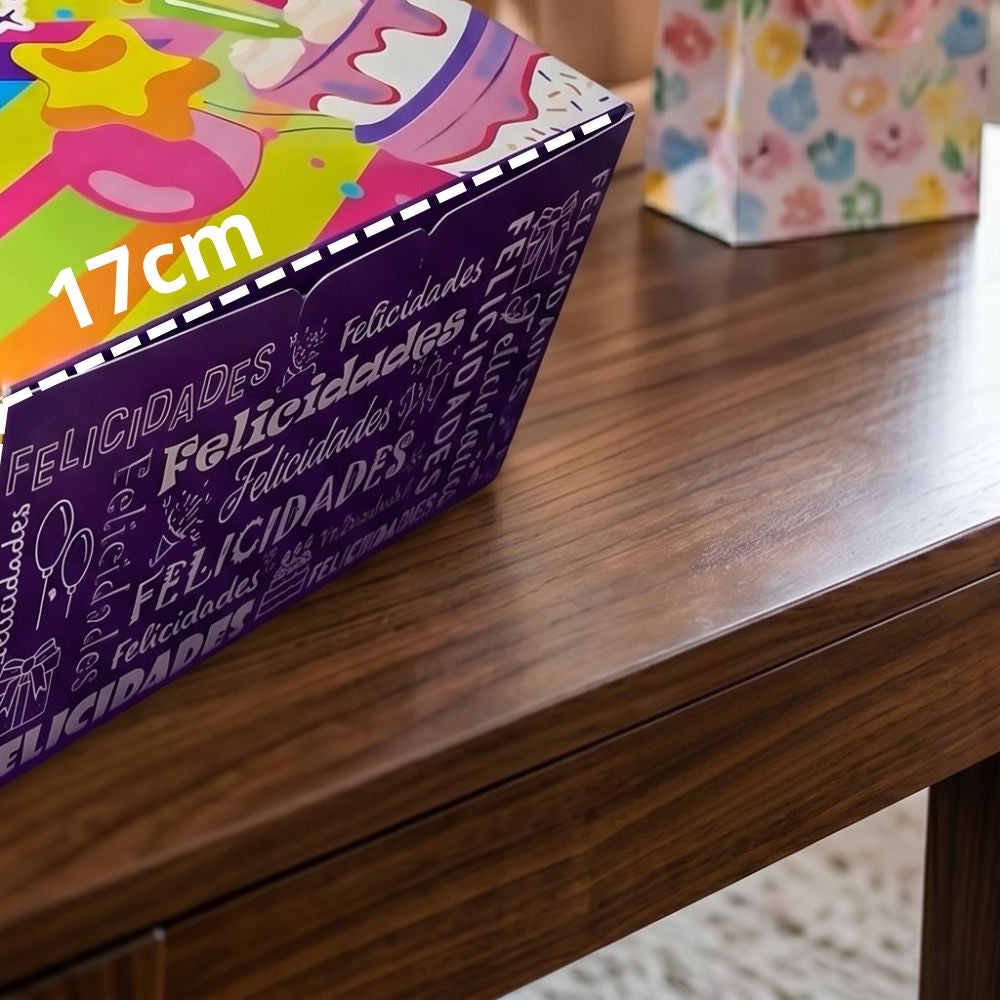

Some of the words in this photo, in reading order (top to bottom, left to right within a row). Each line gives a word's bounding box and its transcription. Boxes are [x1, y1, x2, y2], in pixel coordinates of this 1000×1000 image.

[339, 257, 485, 352] Felicidades
[415, 211, 535, 494] FELICIDADES
[5, 342, 276, 496] FELICIDADES
[157, 308, 467, 497] Felicidades
[218, 396, 393, 524] Felicidades
[129, 430, 415, 626] FELICIDADES
[111, 569, 260, 670] Felicidades
